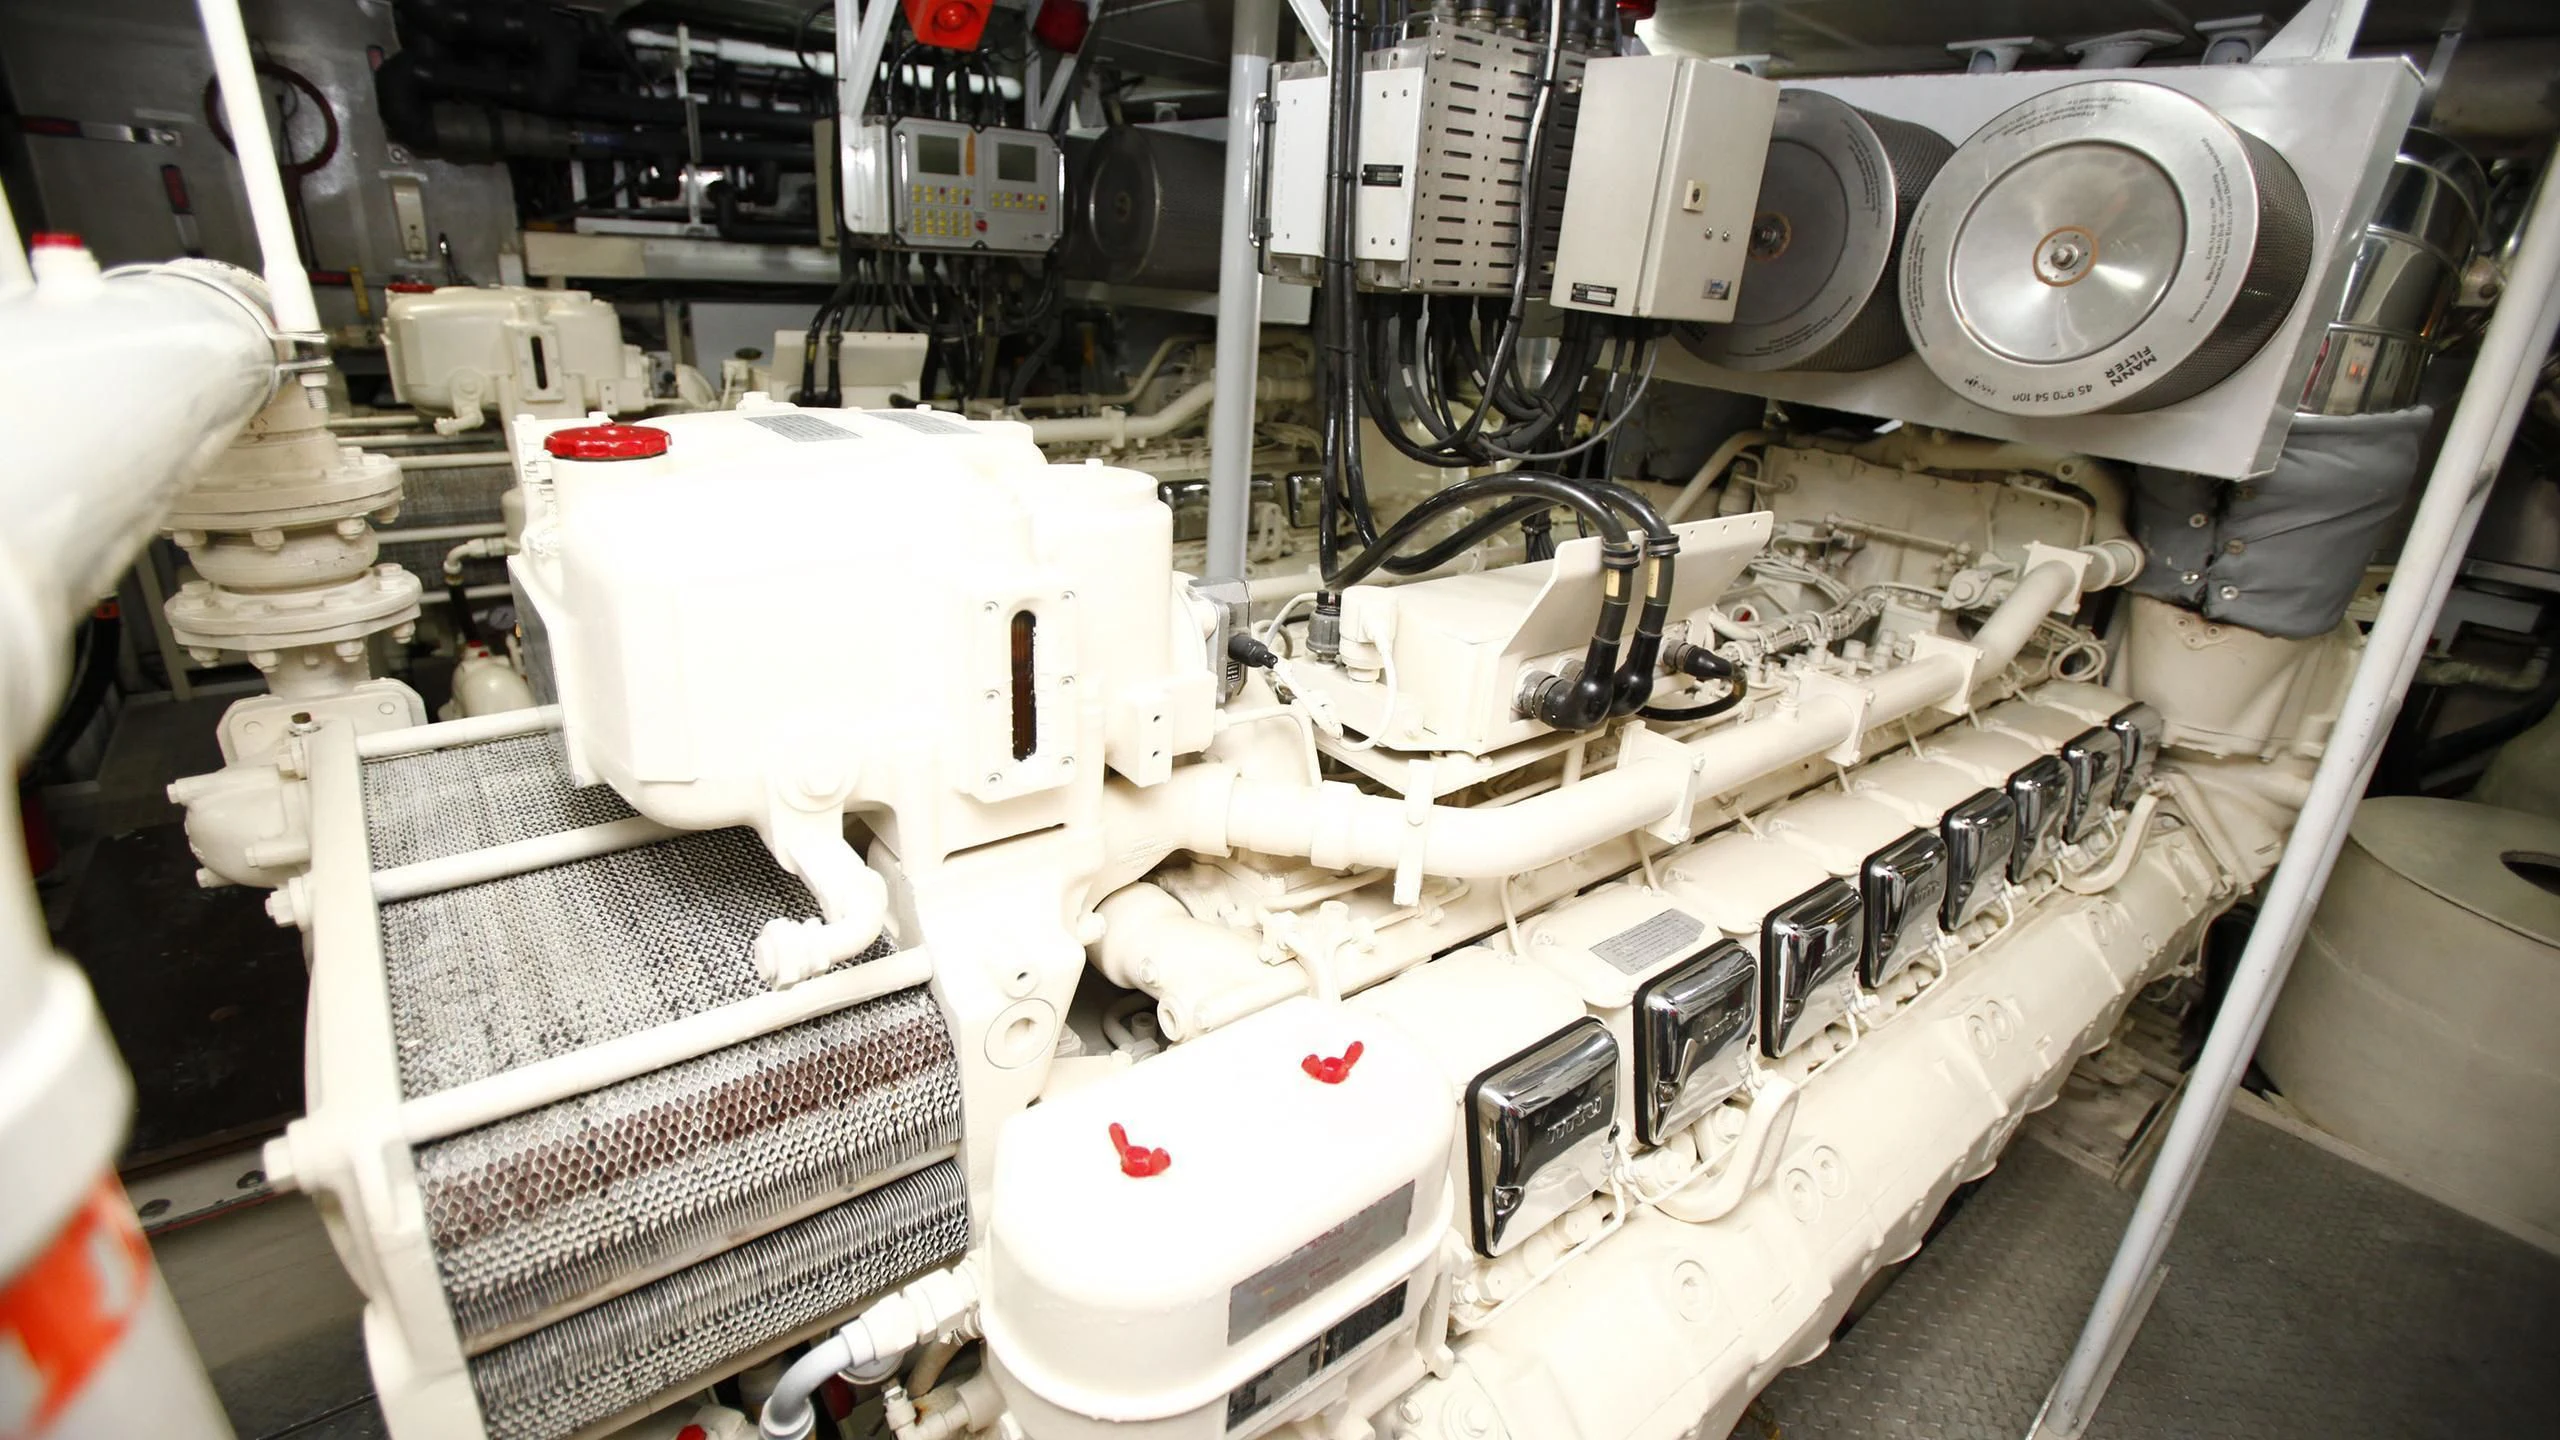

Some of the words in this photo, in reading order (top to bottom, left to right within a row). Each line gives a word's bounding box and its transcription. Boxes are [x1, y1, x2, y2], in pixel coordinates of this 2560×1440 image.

[2104, 346, 2152, 380] FILTER
[2109, 354, 2157, 387] MANN
[2035, 391, 2049, 402] 54
[2078, 383, 2093, 397] 45
[1546, 1096, 1602, 1145] mtu
